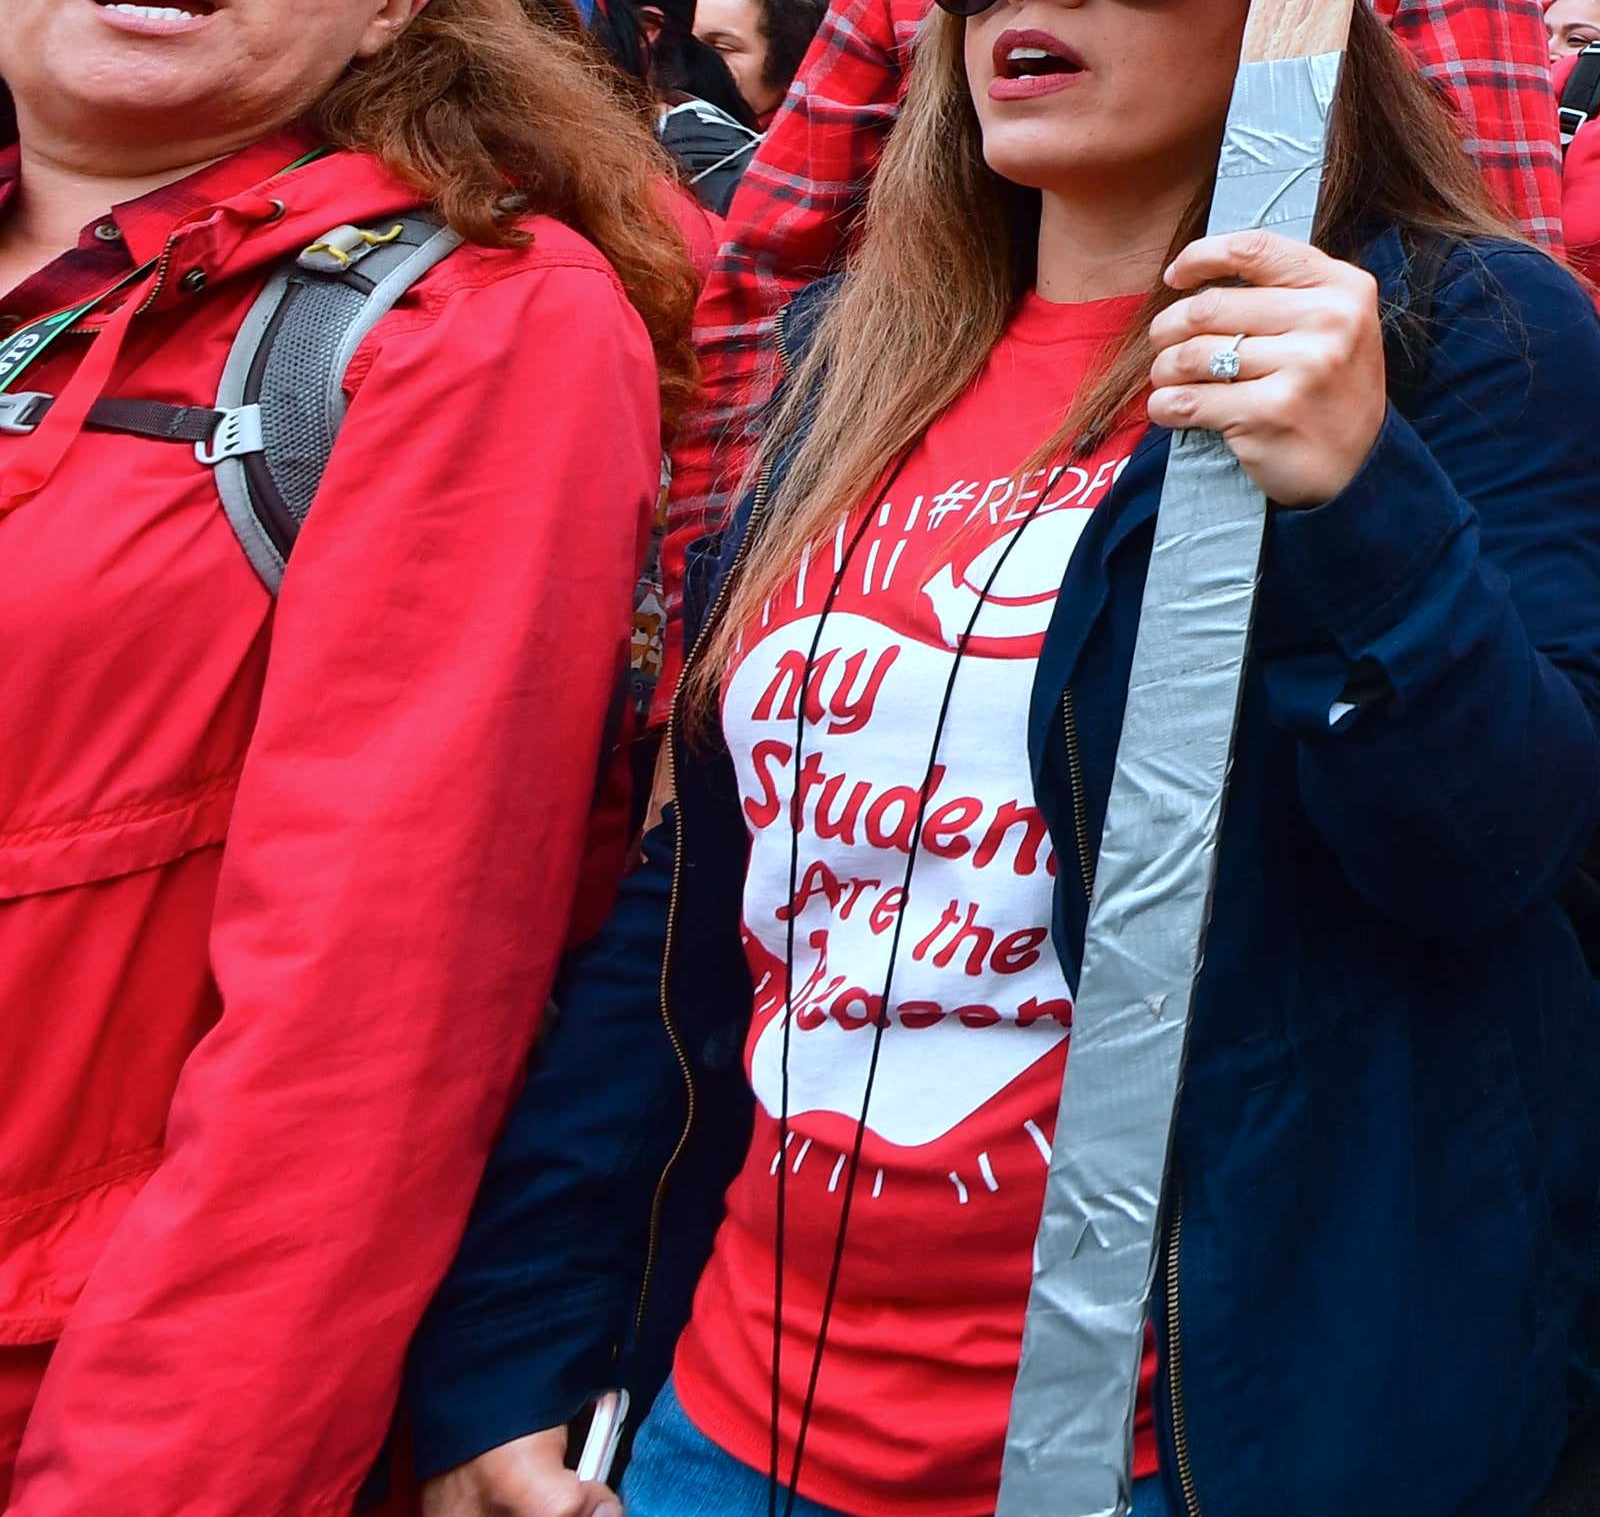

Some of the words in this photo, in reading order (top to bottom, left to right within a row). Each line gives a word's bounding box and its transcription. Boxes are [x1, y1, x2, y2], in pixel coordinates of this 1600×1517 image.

[745, 739, 1057, 876] Studen
[776, 860, 909, 935] Are
[911, 899, 1048, 976] the
